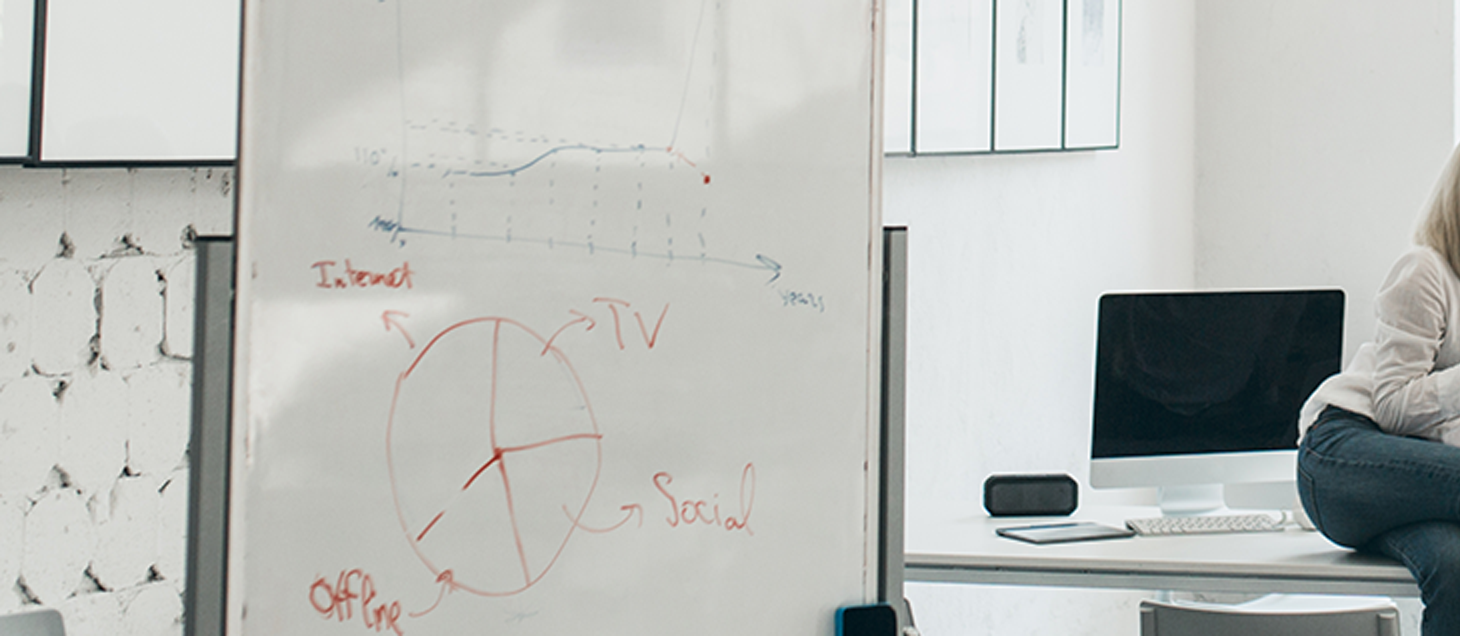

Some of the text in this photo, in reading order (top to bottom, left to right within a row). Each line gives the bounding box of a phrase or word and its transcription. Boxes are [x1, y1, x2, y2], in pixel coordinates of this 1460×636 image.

[310, 258, 416, 289] Internet
[592, 296, 671, 351] TV
[652, 461, 756, 536] Social
[308, 568, 404, 636] Offline
